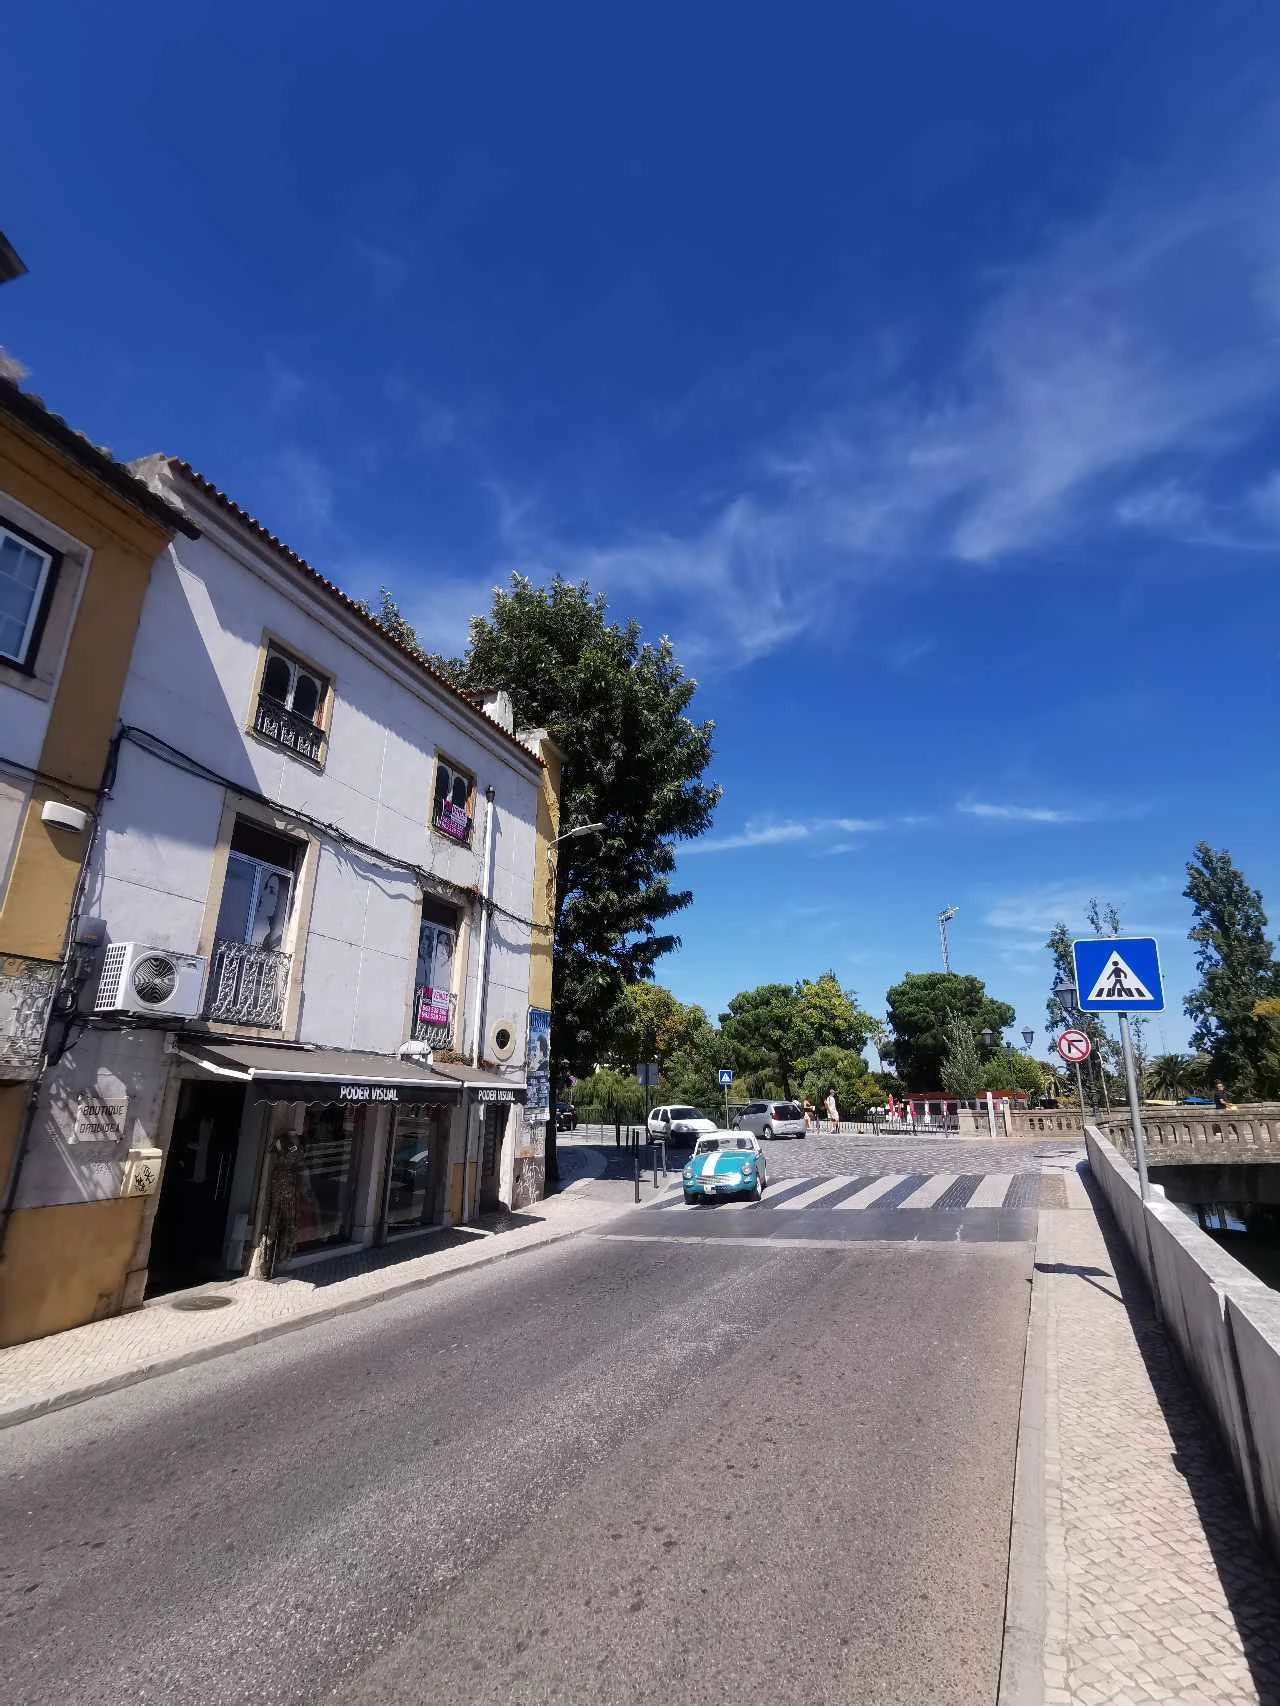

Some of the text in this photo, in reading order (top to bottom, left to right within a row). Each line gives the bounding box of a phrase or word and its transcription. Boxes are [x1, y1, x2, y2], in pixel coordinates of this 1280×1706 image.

[340, 1085, 399, 1101] PODER VISUAL
[478, 1089, 516, 1101] PODER VISUAL
[82, 1105, 125, 1116] BOUTIQUE
